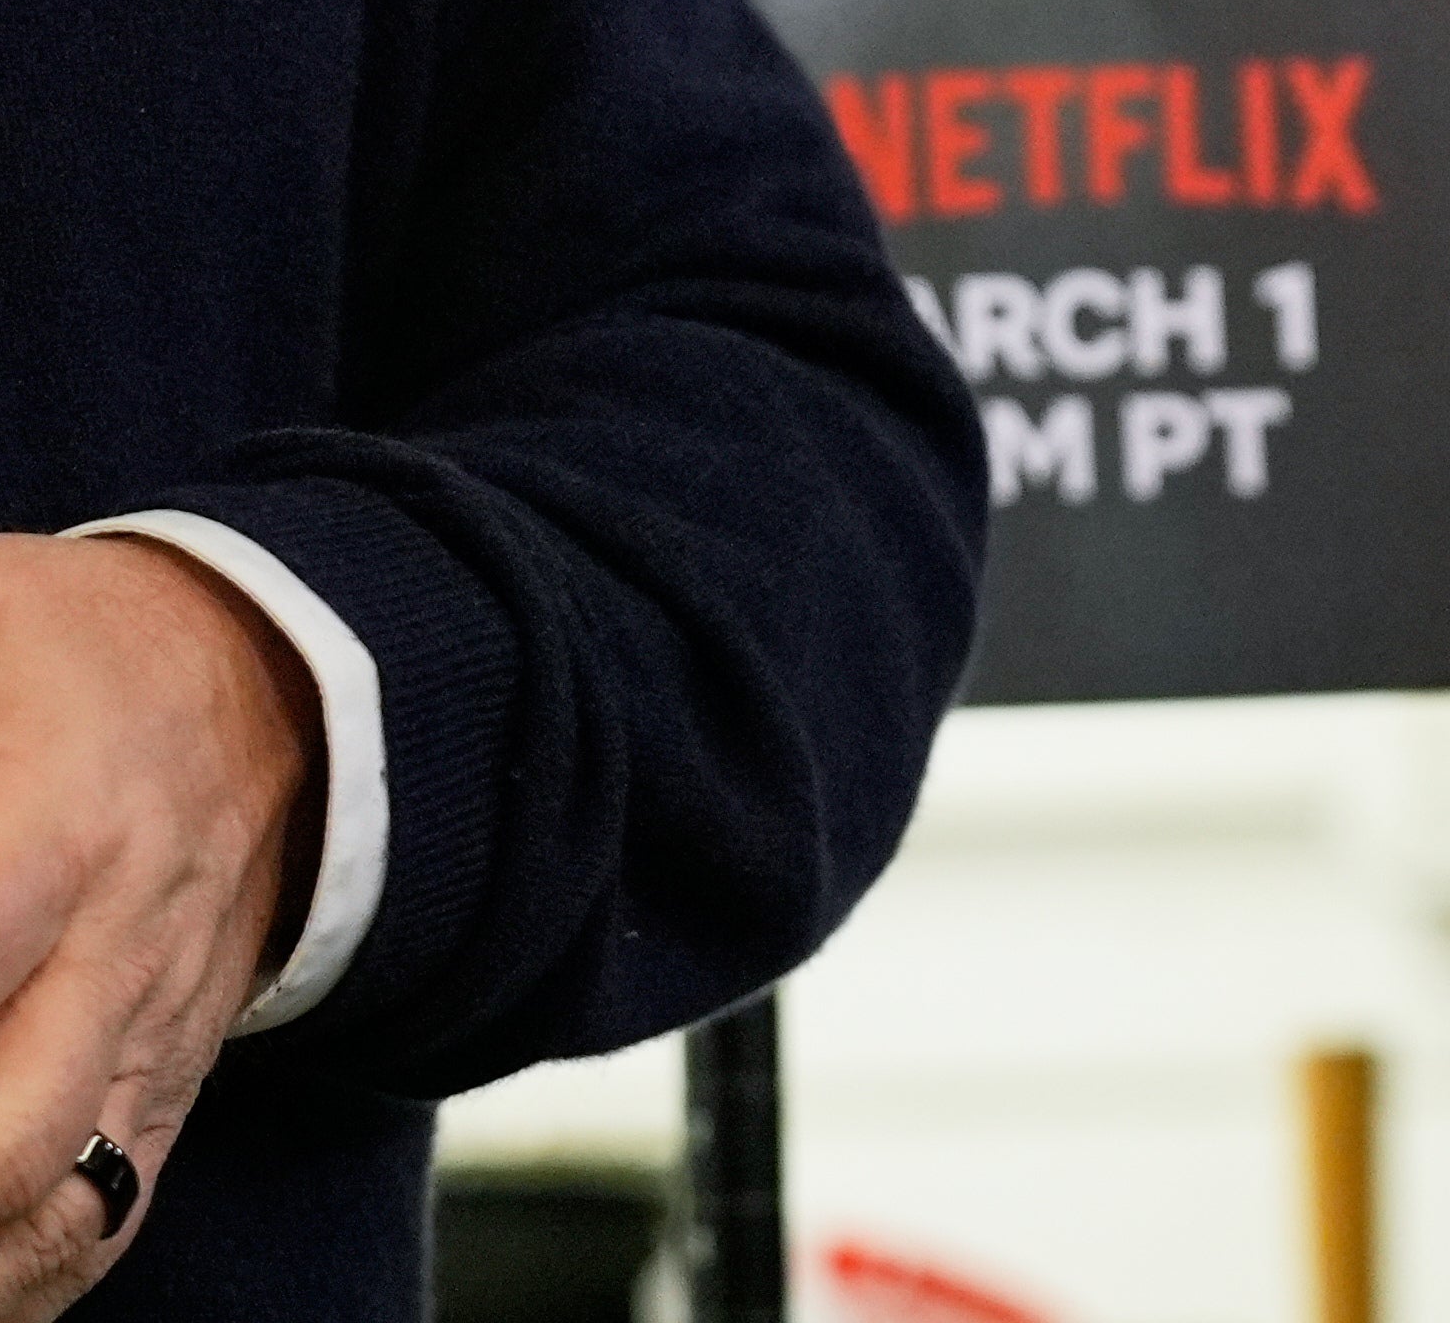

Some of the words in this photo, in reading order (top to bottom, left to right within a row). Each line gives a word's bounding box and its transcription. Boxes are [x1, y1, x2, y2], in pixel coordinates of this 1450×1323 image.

[824, 54, 1382, 224] NETFLIX
[1253, 260, 1320, 372] 1
[1118, 386, 1295, 502] PT
